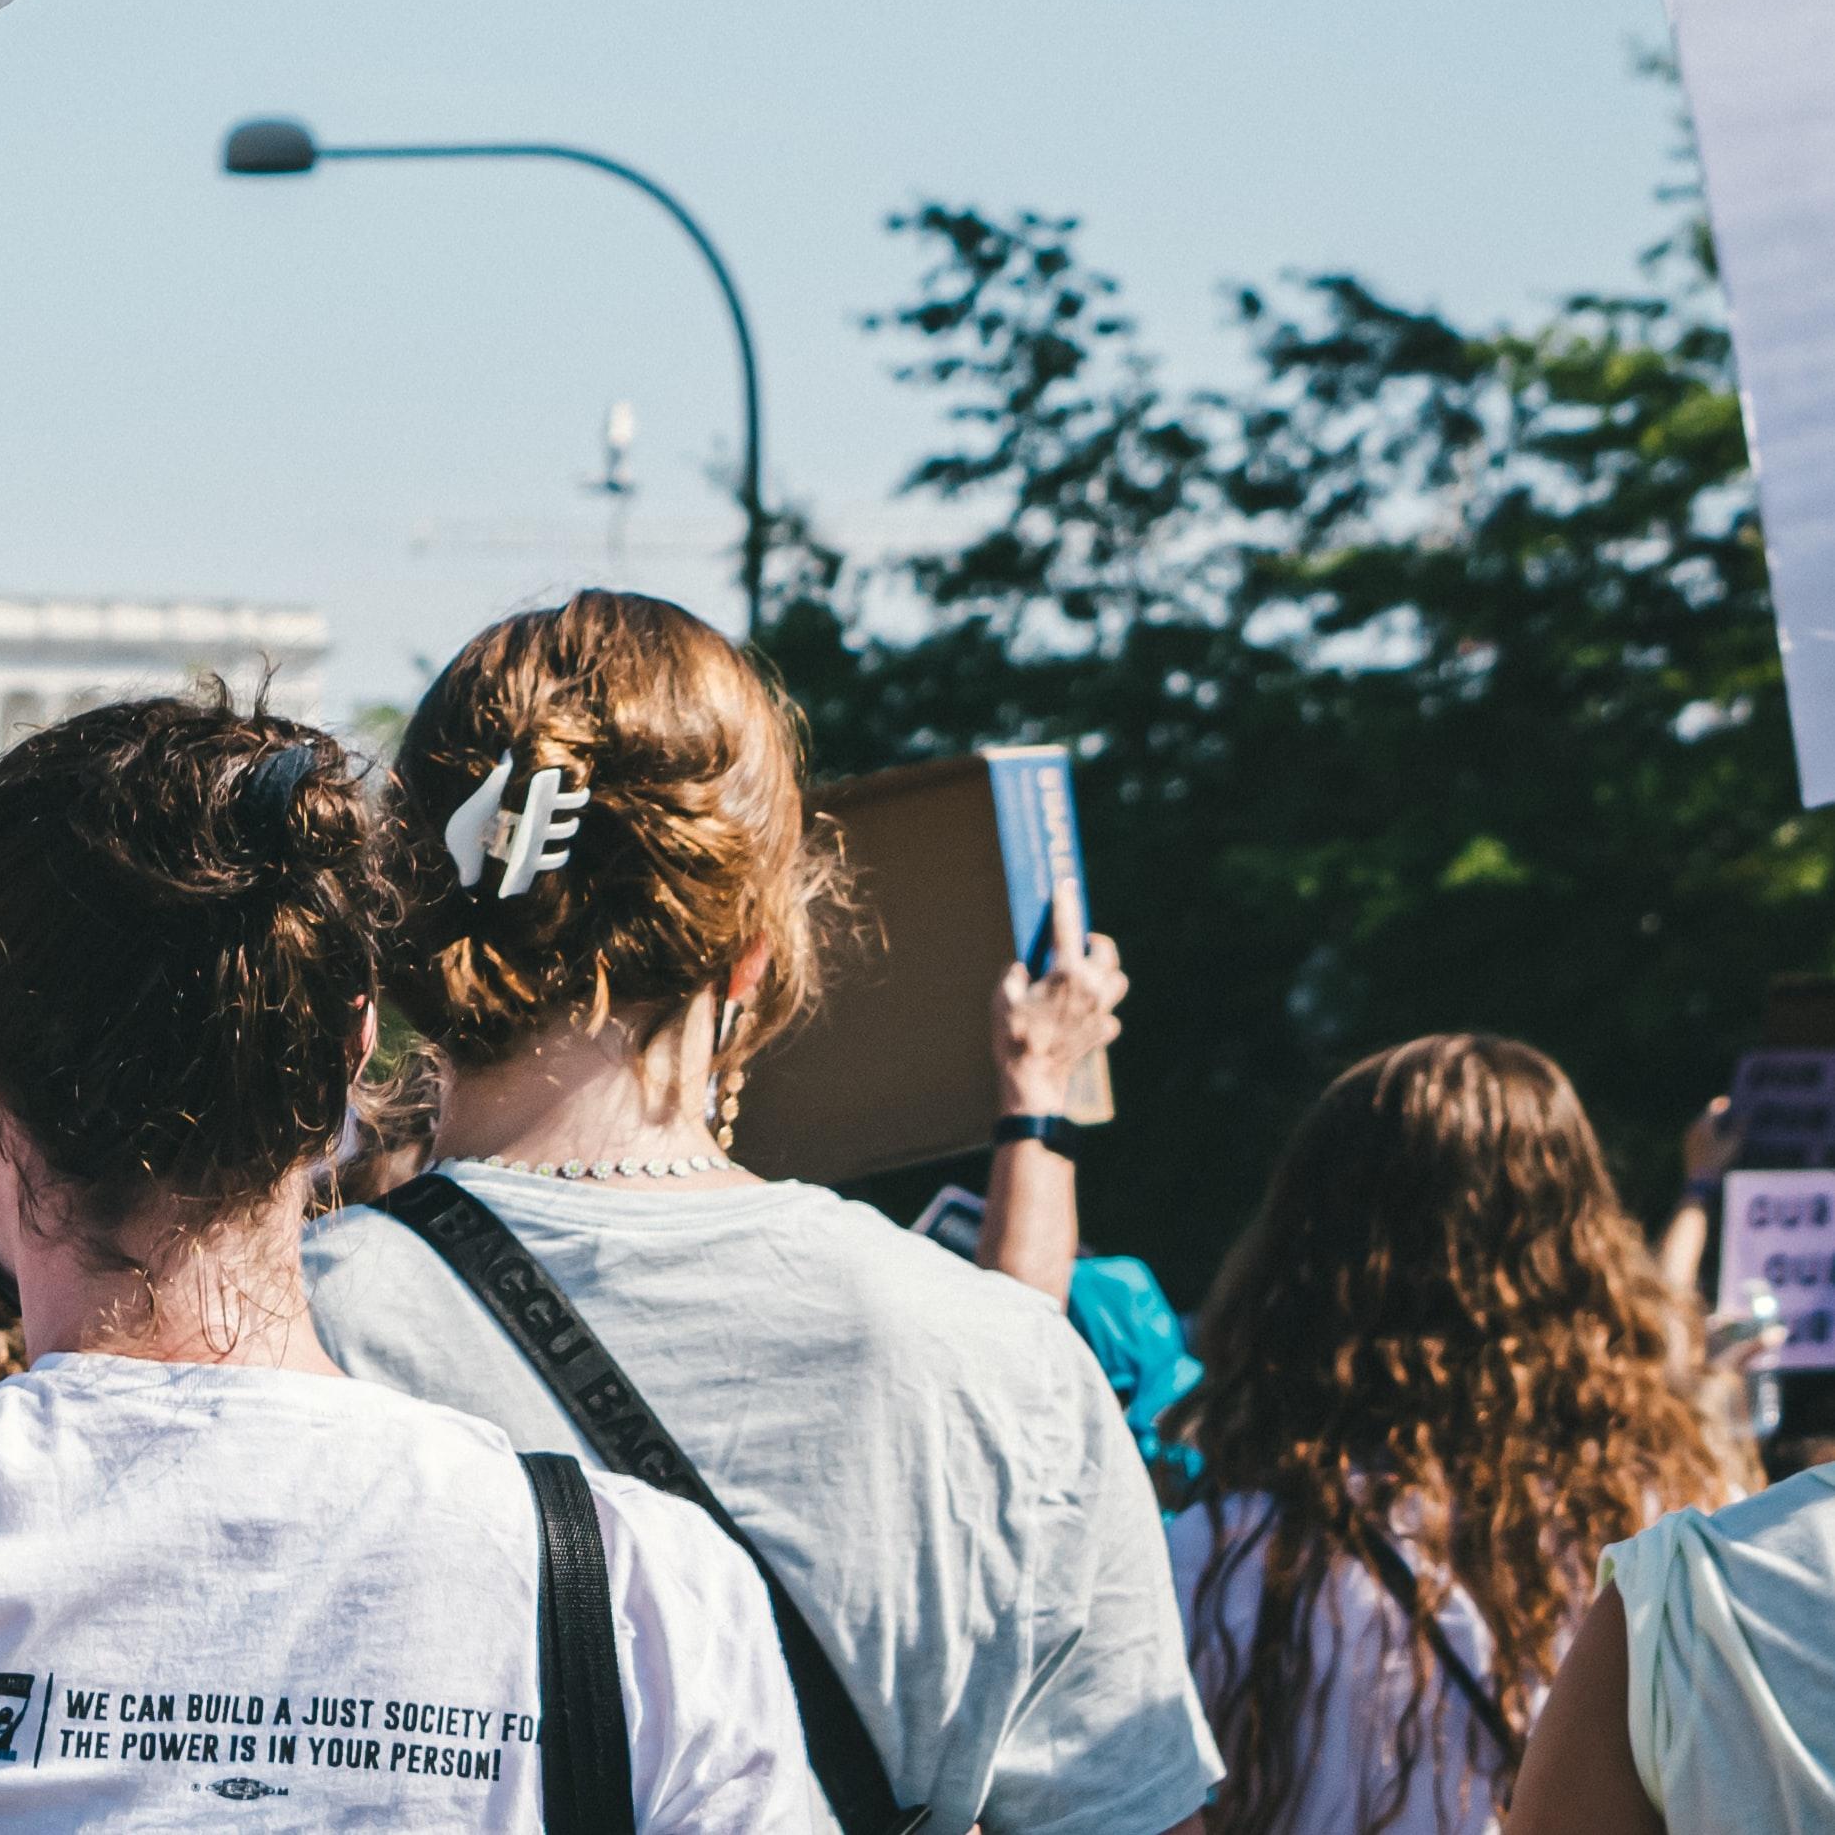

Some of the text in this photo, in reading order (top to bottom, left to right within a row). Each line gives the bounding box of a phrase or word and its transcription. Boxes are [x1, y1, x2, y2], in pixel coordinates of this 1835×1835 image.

[428, 1200, 592, 1364] BAGGU
[67, 1689, 540, 1744] WE CAN BUILD A JUST SOCIETY FO
[60, 1729, 501, 1781] THE POWER IS IN YOUR PERSON!
